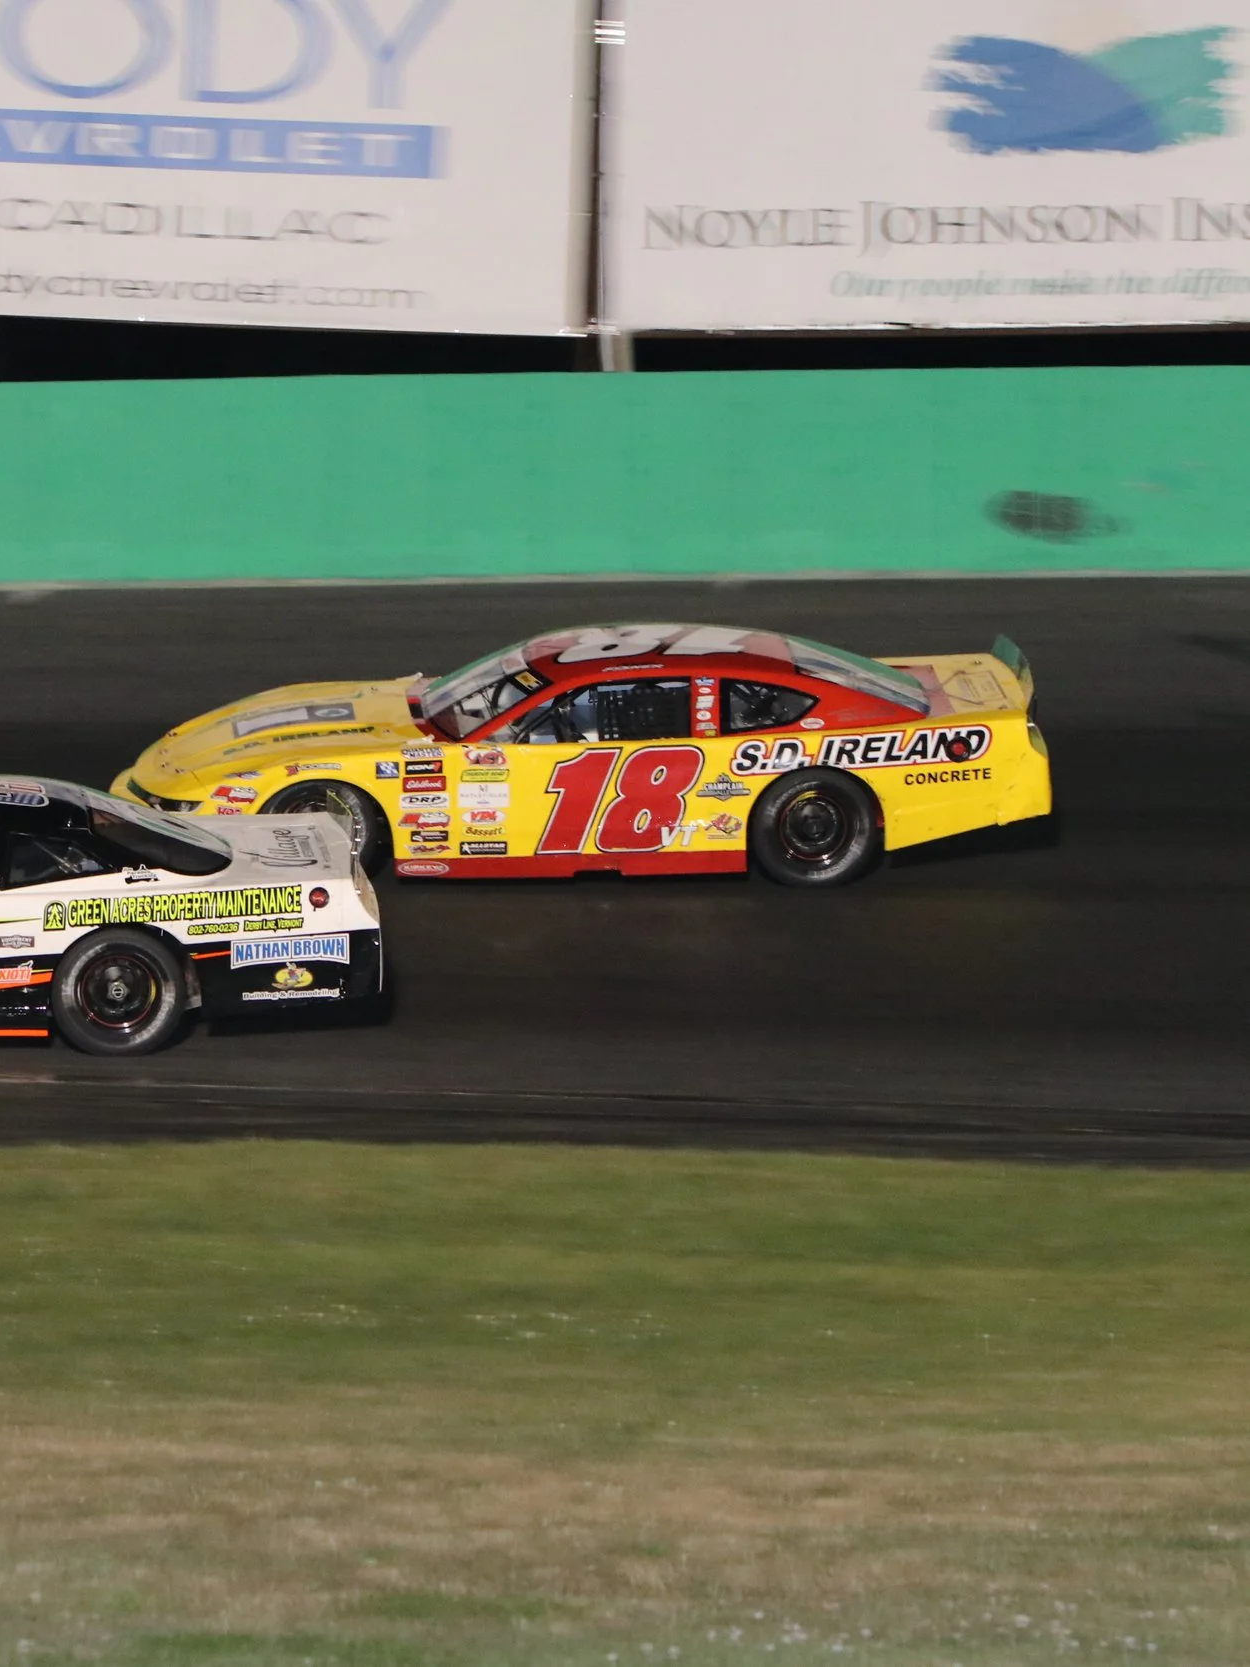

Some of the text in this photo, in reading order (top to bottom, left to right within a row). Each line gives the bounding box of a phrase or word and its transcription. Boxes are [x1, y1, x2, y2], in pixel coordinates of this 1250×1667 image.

[642, 203, 852, 250] NOYLE
[858, 200, 1162, 257] JOHNSON
[897, 269, 1007, 303] people
[703, 782, 744, 791] CHAMPLAIN
[904, 768, 992, 786] CONCRETE
[537, 746, 704, 854] 18
[660, 825, 699, 847] VT
[68, 884, 302, 927] GREEN ACRES PROPERTY MAINTENANCE
[235, 937, 345, 963] NATHAN BROWN
[242, 990, 278, 1000] Building
[288, 988, 340, 999] Remodeling
